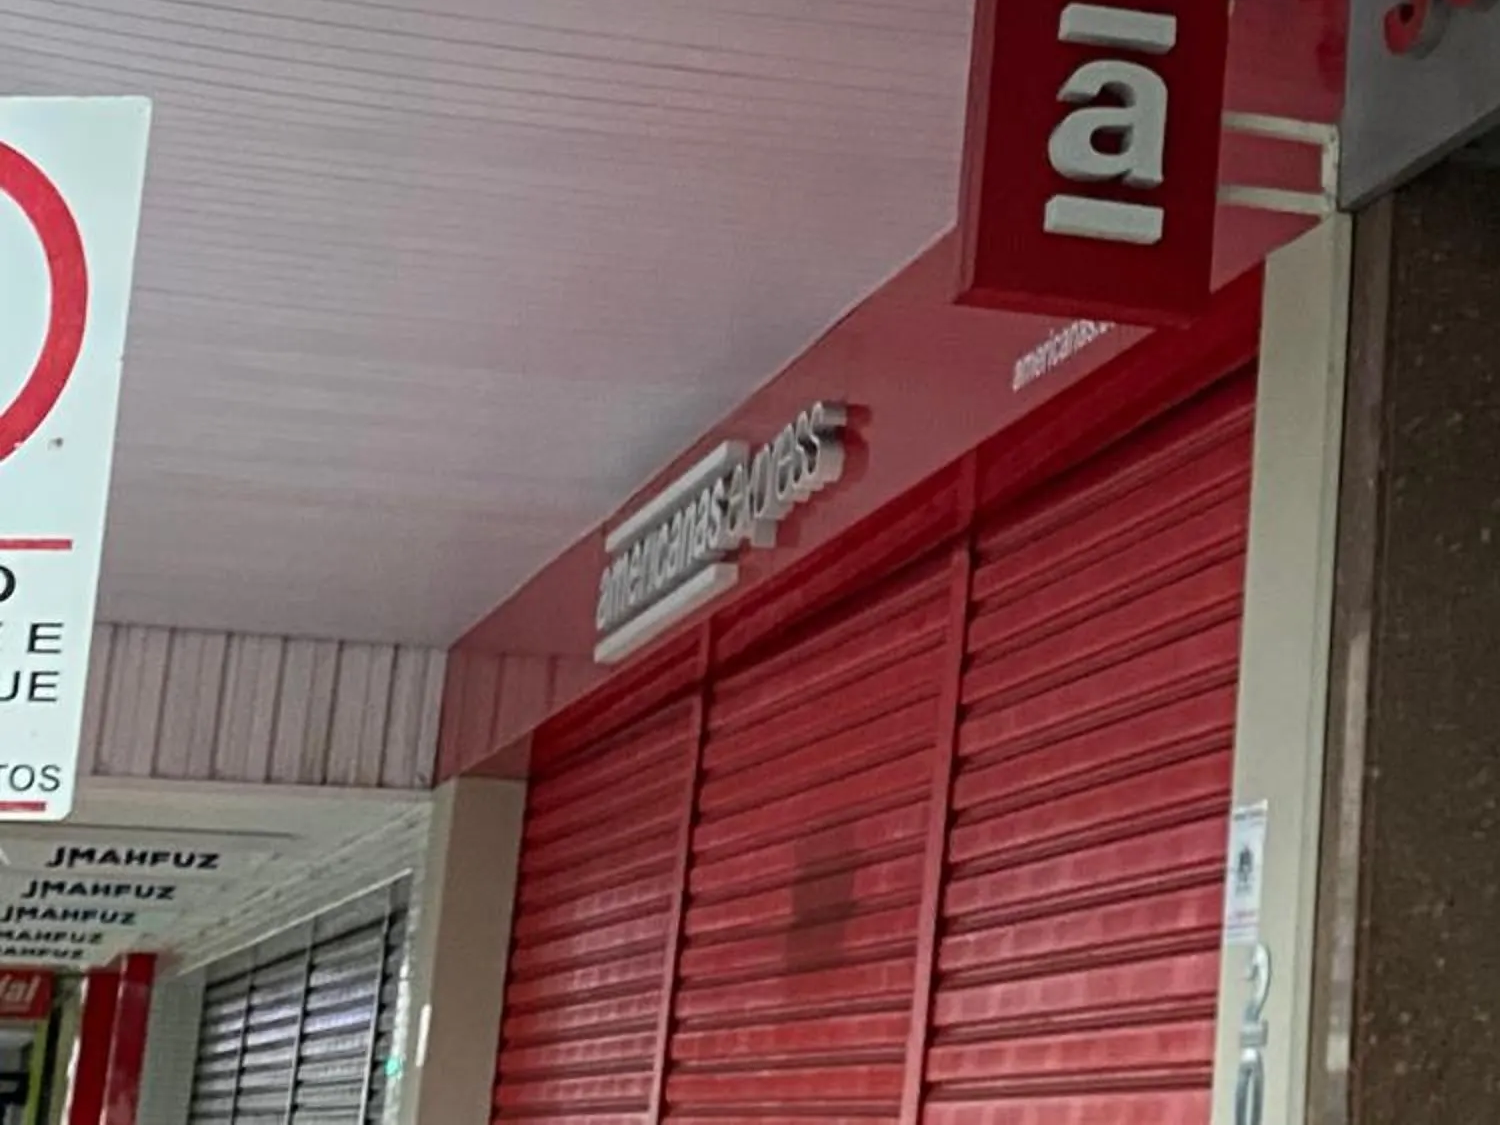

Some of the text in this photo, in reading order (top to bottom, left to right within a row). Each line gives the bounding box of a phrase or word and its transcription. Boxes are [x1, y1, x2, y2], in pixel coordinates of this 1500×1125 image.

[45, 846, 221, 870] JMAHFUZ
[20, 879, 177, 901] JMAHFUZ
[0, 905, 137, 926] JMAHFUZ
